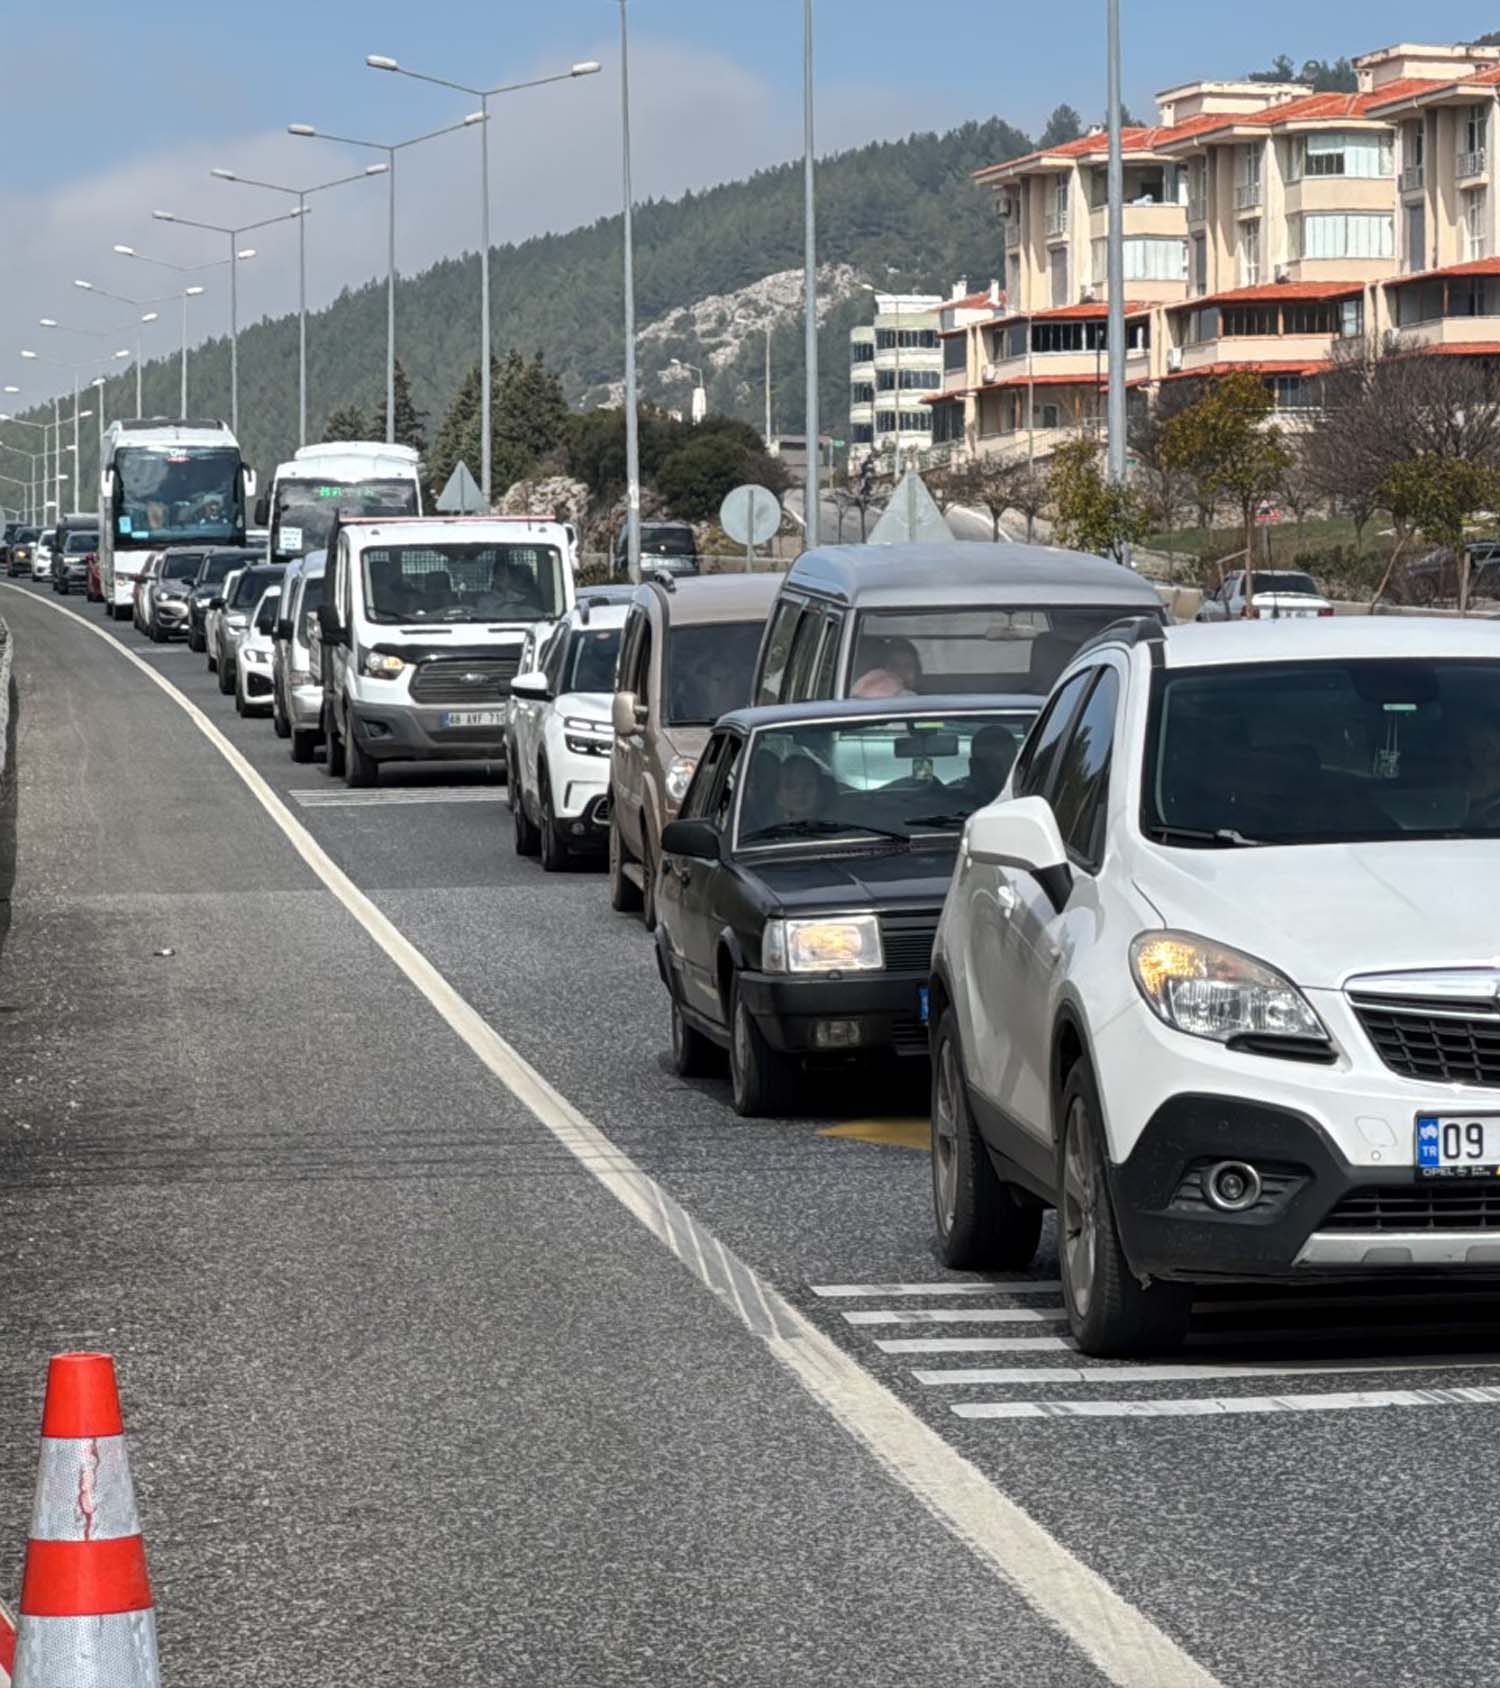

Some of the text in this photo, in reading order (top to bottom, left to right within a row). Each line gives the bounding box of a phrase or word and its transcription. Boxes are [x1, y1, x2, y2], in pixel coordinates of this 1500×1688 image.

[1422, 1145, 1437, 1157] TR
[1443, 1123, 1483, 1159] 09
[1422, 1167, 1454, 1177] OPEL
